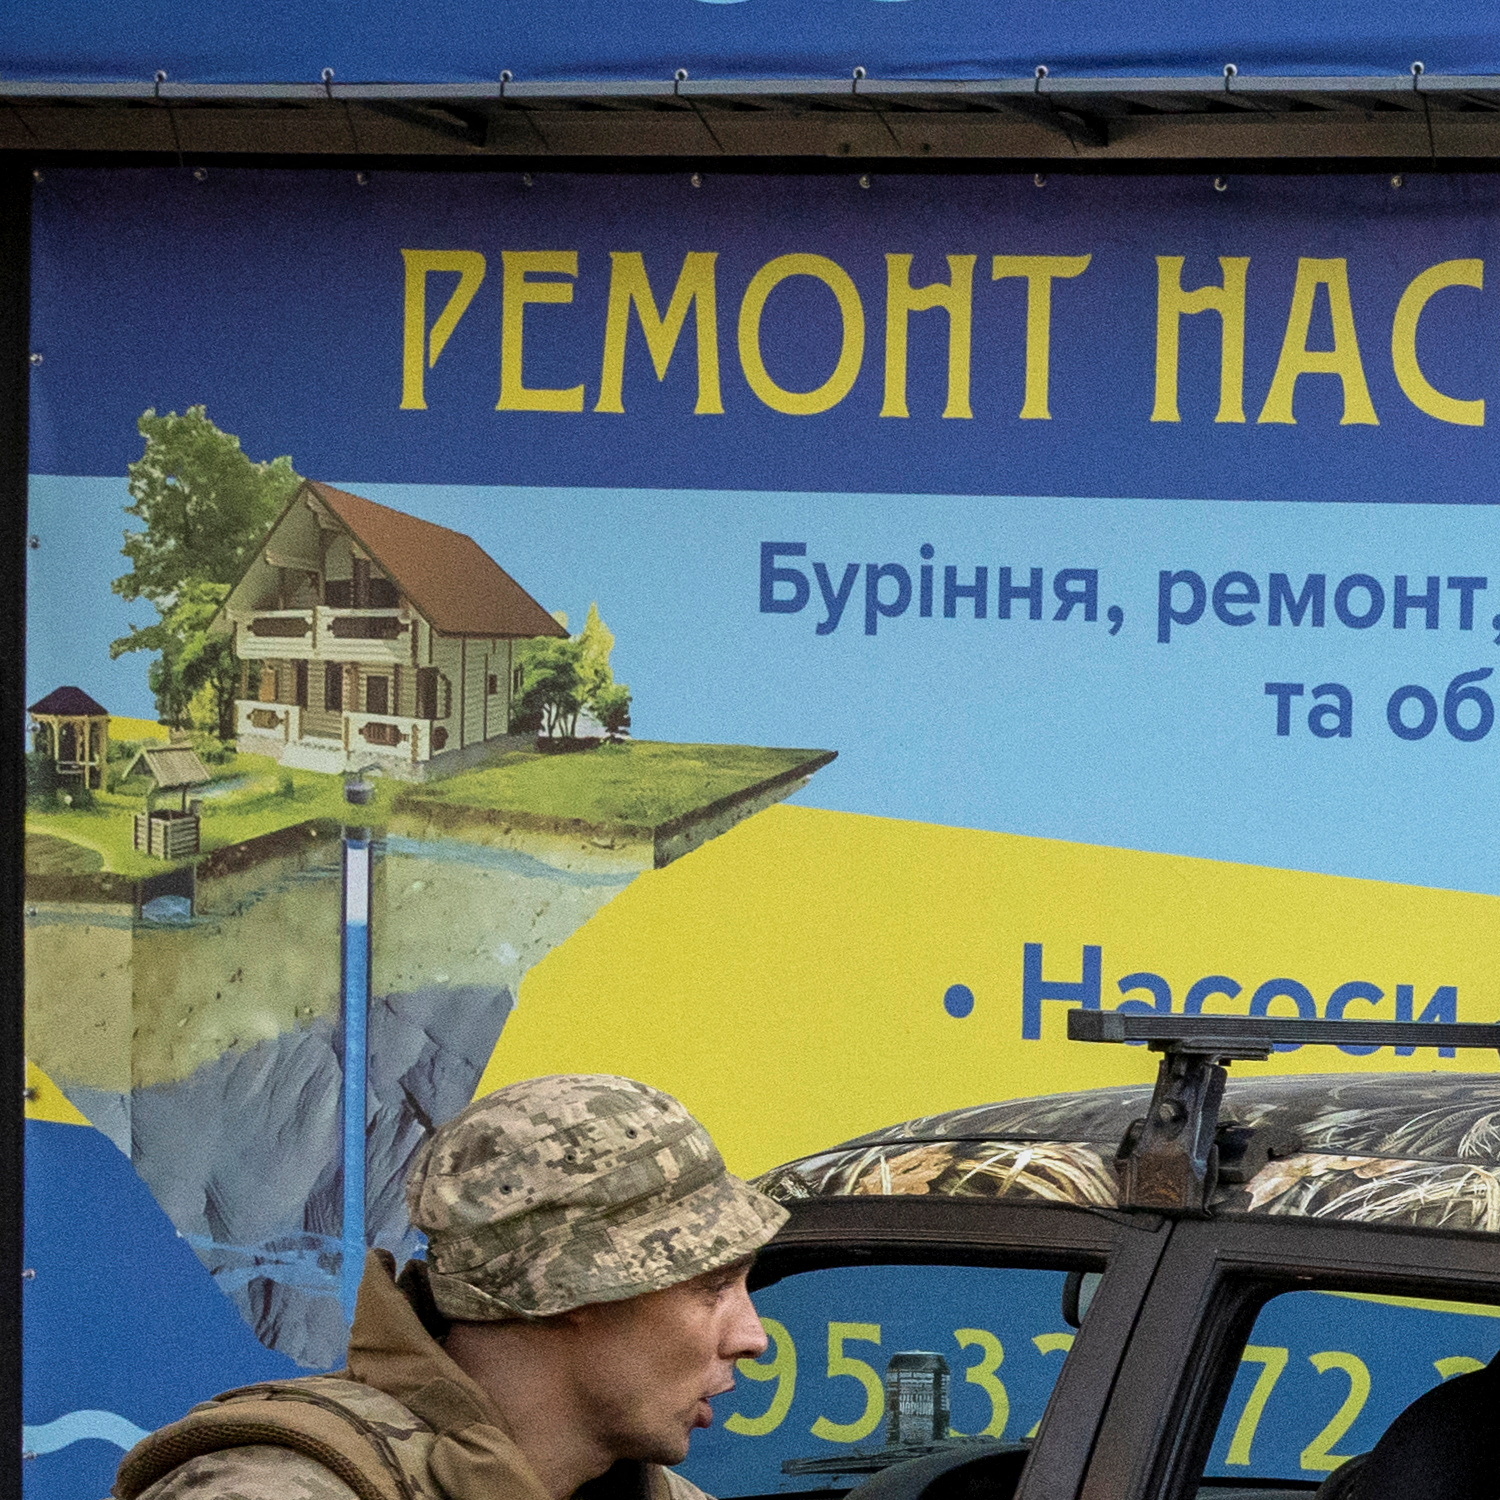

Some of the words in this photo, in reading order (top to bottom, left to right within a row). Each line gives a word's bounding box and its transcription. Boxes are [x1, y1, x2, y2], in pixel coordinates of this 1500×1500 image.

[398, 250, 1093, 420] РЕМОНТ
[757, 539, 1126, 637] Буріння,
[1263, 681, 1354, 740] та
